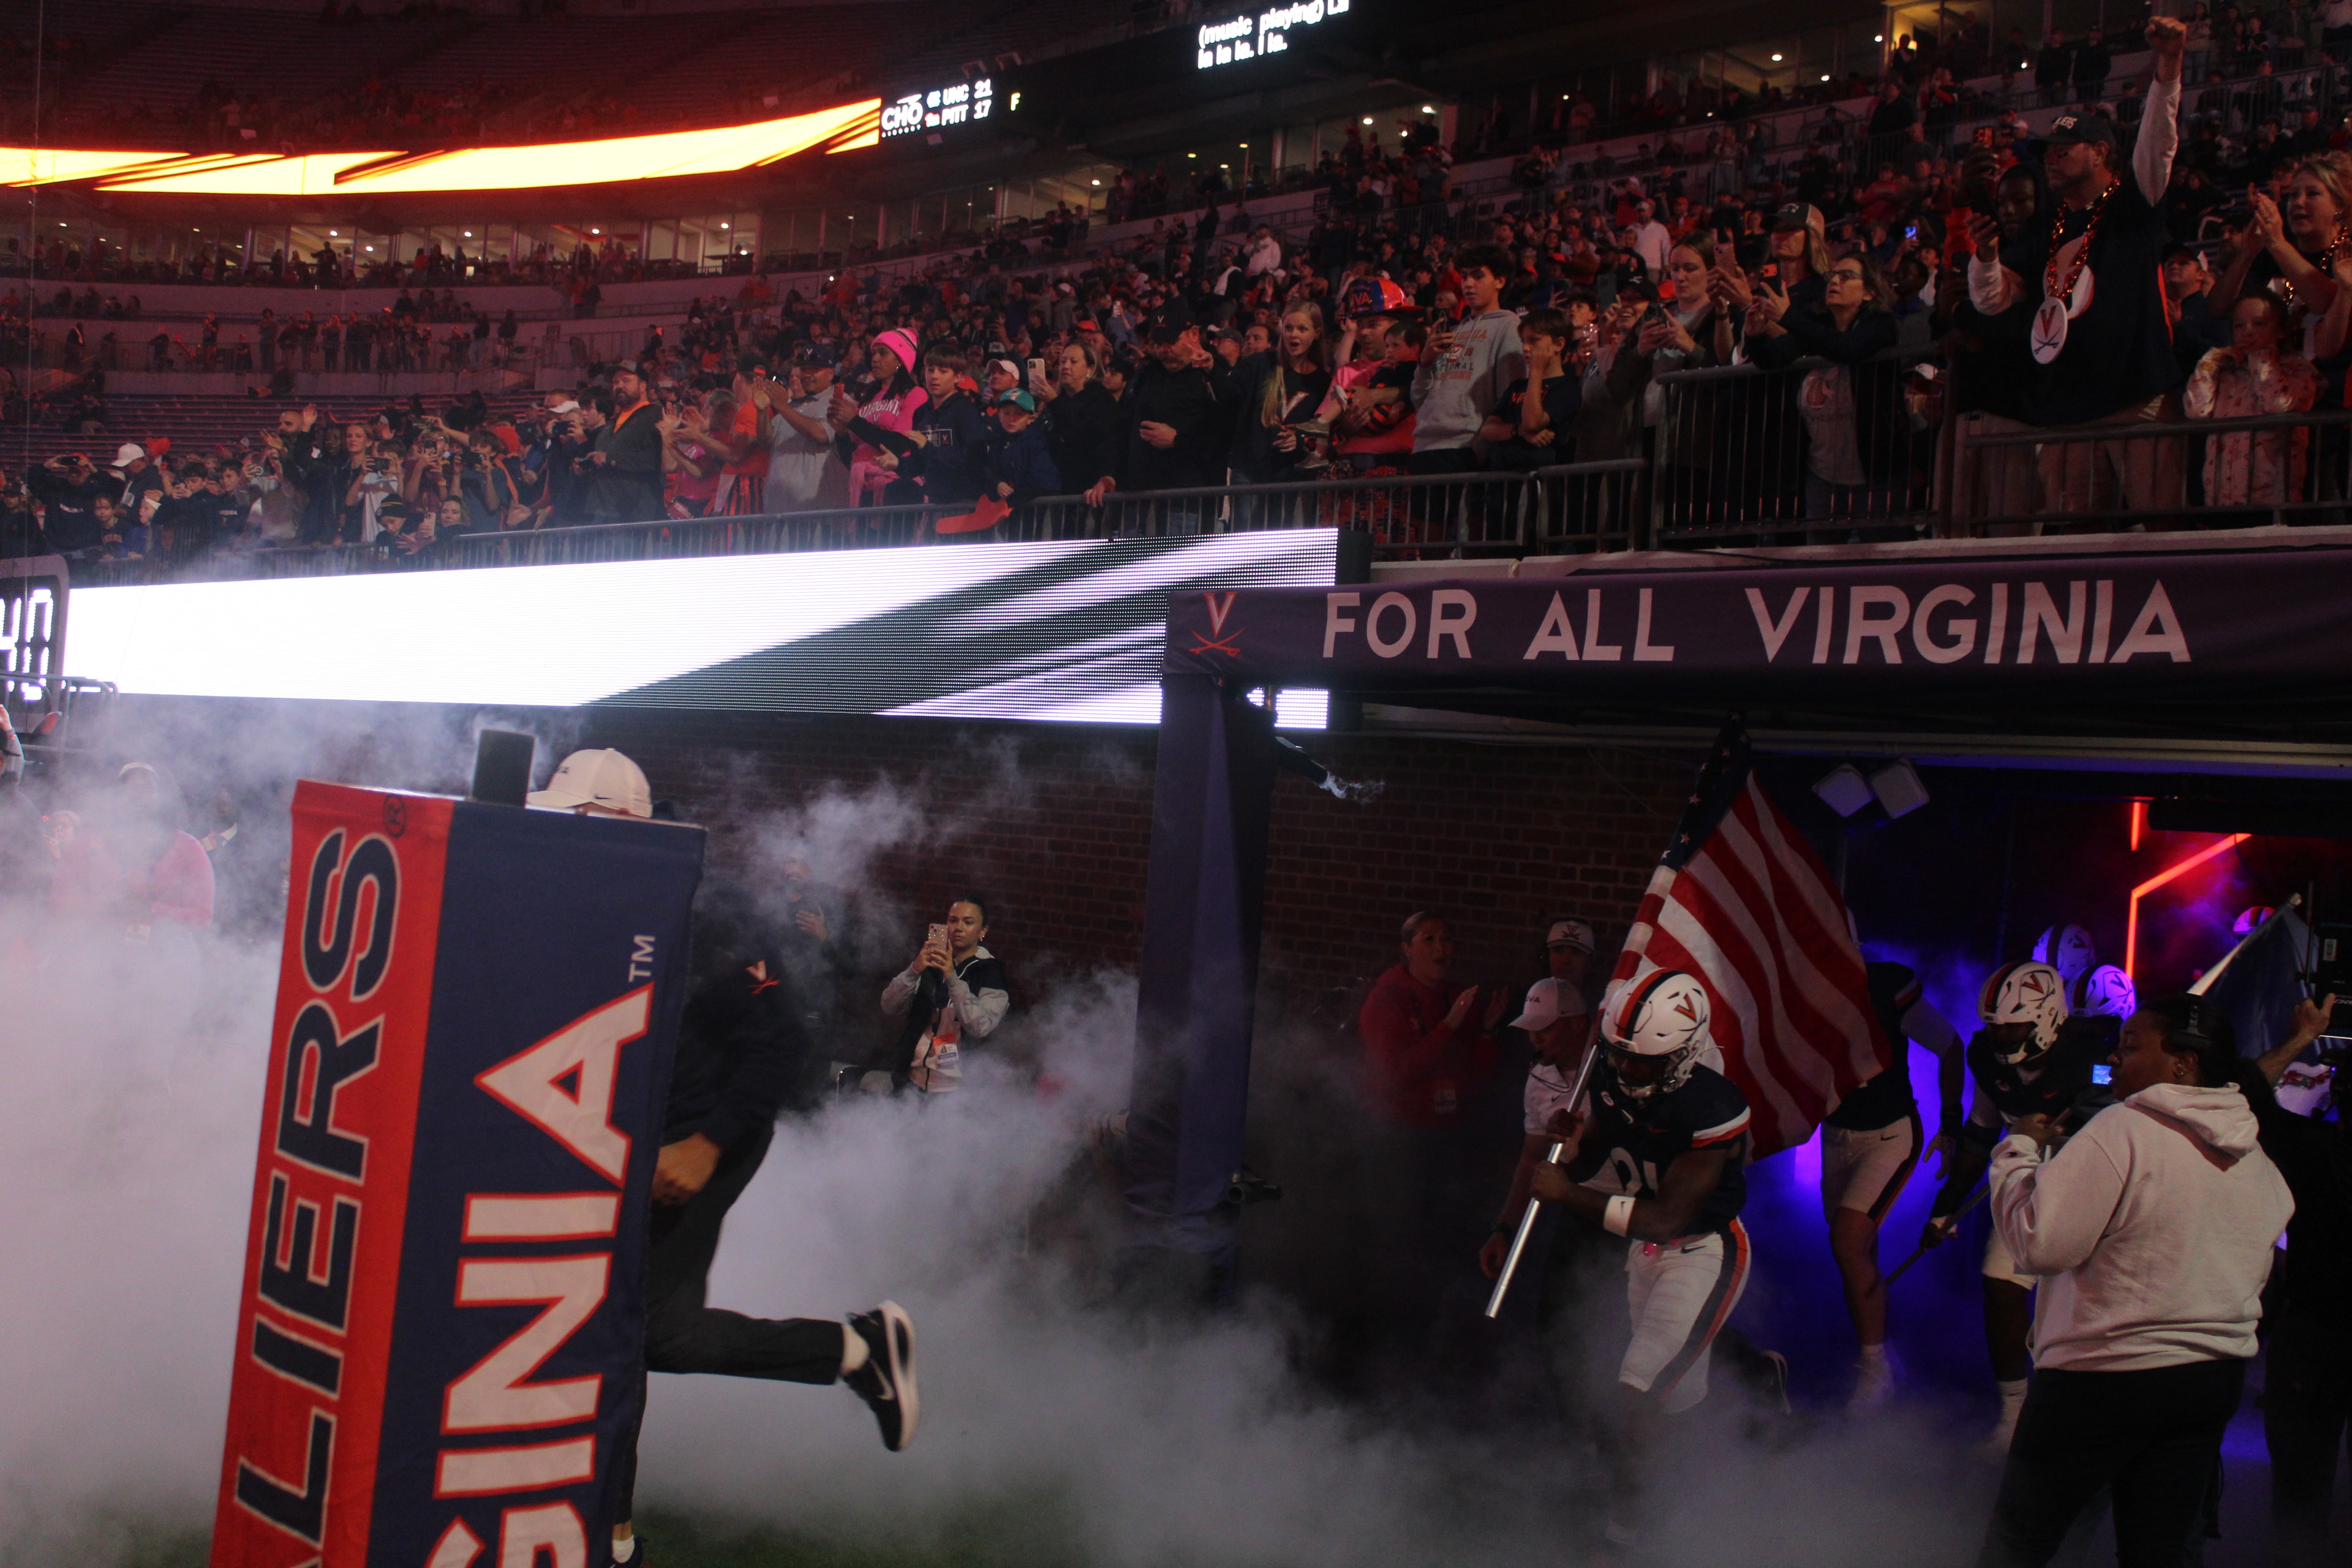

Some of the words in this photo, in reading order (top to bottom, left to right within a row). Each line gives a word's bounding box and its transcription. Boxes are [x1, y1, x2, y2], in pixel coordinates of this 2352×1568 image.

[1199, 15, 1253, 48] (music
[1260, 0, 1324, 34] playing)
[1198, 49, 1213, 69] la
[1216, 44, 1232, 65] la
[1235, 40, 1254, 61] la.
[1267, 32, 1287, 54] la.
[943, 85, 969, 105] UNC
[974, 78, 992, 99] 21
[1011, 92, 1020, 111] F
[881, 102, 923, 130] CHO
[941, 104, 968, 126] PITT
[974, 99, 992, 119] 17
[859, 398, 900, 417] VIRGINI
[1323, 589, 1477, 658] FOR
[1523, 588, 1675, 661] ALL
[1744, 579, 2191, 664] VIRGINIA
[233, 827, 402, 1568] LIERS
